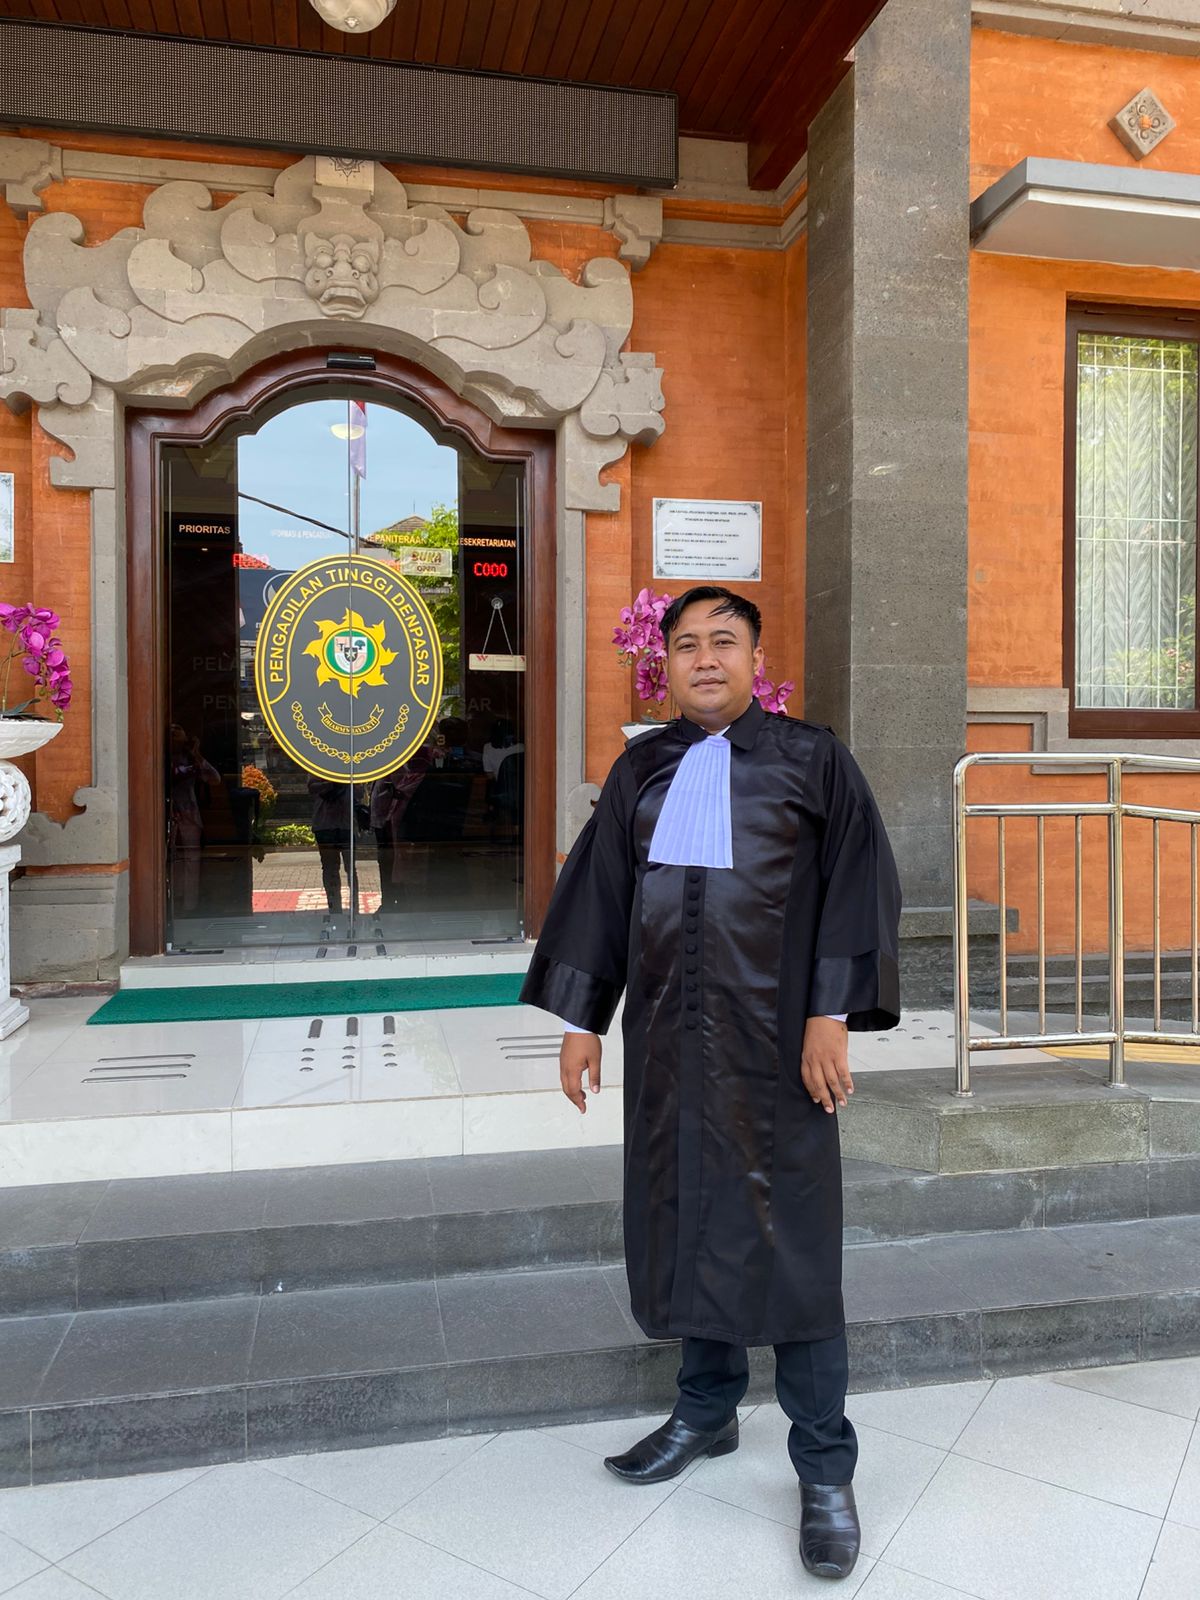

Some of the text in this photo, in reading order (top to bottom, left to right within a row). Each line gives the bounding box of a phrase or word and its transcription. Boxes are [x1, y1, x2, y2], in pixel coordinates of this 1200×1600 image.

[179, 524, 231, 535] PRIORITAS
[457, 537, 517, 548] ESEKRETARIATAN
[473, 562, 508, 577] C000
[269, 568, 430, 686] PENGADILAN TINGGI DENPASAR
